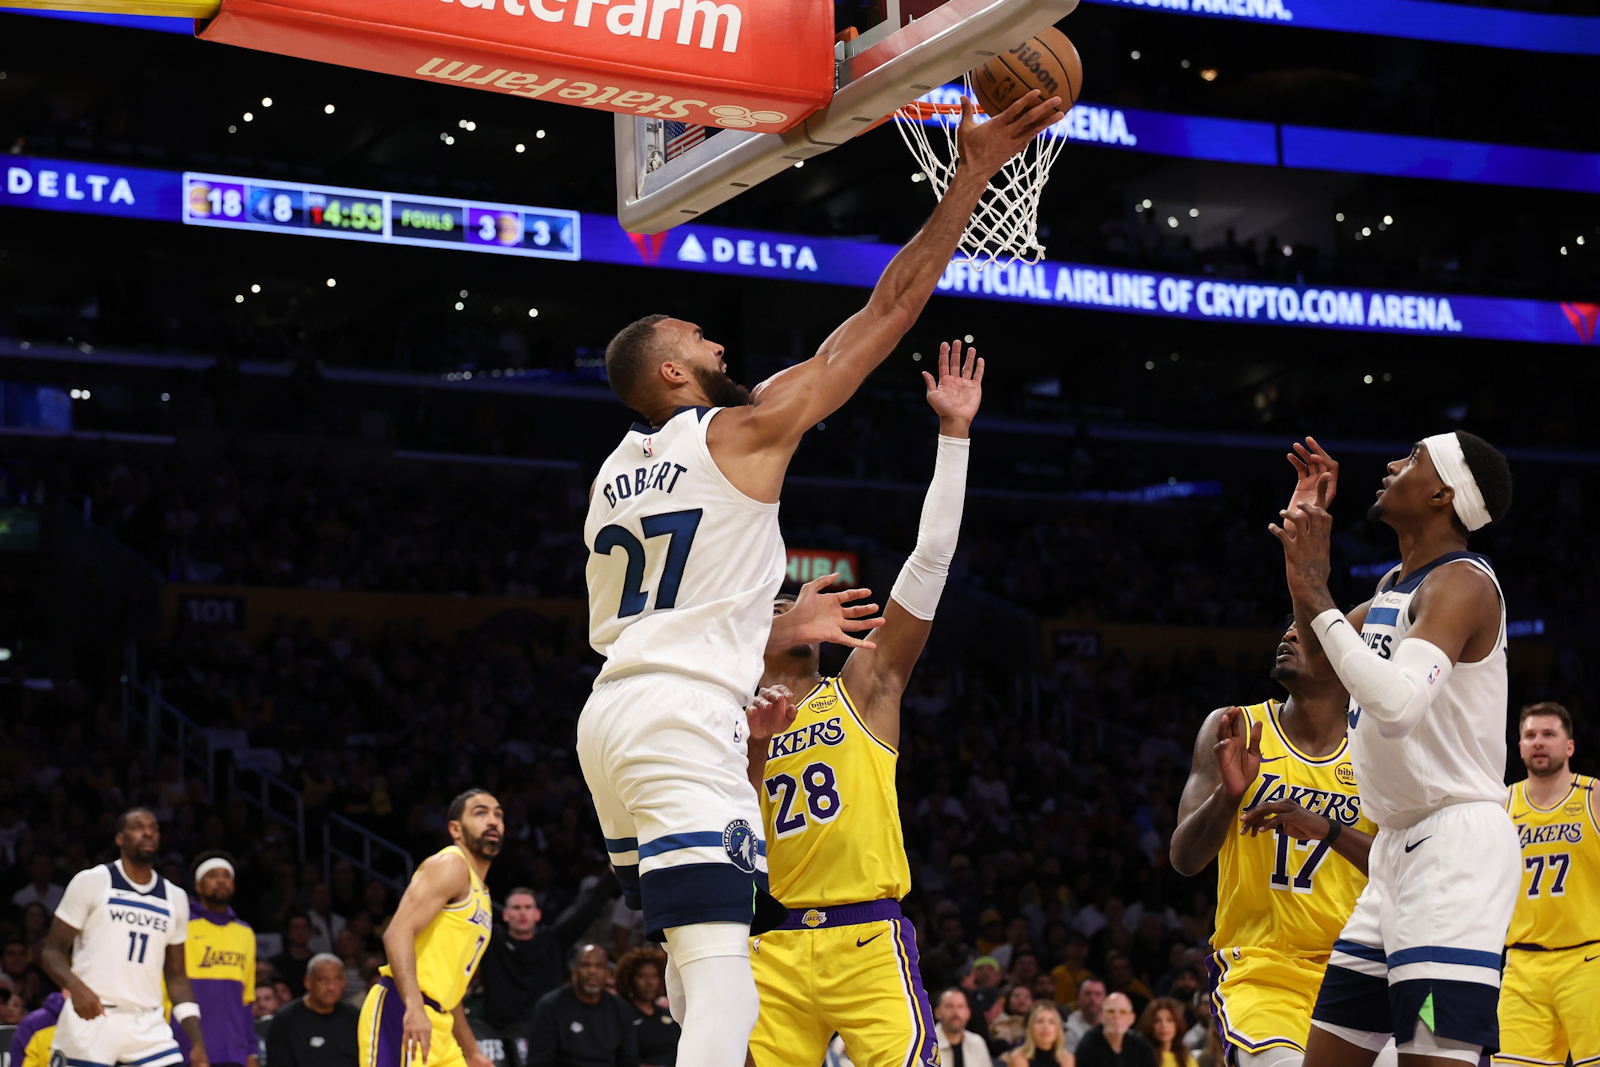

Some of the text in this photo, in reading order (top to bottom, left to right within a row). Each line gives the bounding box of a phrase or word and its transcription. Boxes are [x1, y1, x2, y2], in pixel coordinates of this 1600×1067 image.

[415, 57, 708, 119] StateFarm
[7, 166, 136, 205] DELTA
[207, 188, 242, 218] 18
[273, 193, 293, 223] 8
[323, 199, 383, 231] 4:53
[401, 208, 454, 232] FOULS
[478, 214, 497, 241] 3
[533, 220, 551, 246] 3
[712, 236, 819, 272] DELTA
[936, 256, 1462, 332] OFFICIAL AIRLINE OF CRYPTO.COM ARENA.
[603, 461, 688, 510] GOBERT
[593, 507, 703, 619] 27
[763, 761, 843, 840] 28
[1269, 822, 1332, 895] 17
[1524, 852, 1571, 899] 77
[110, 909, 168, 933] WOLVES
[128, 930, 149, 964] 11
[464, 934, 486, 976] 7
